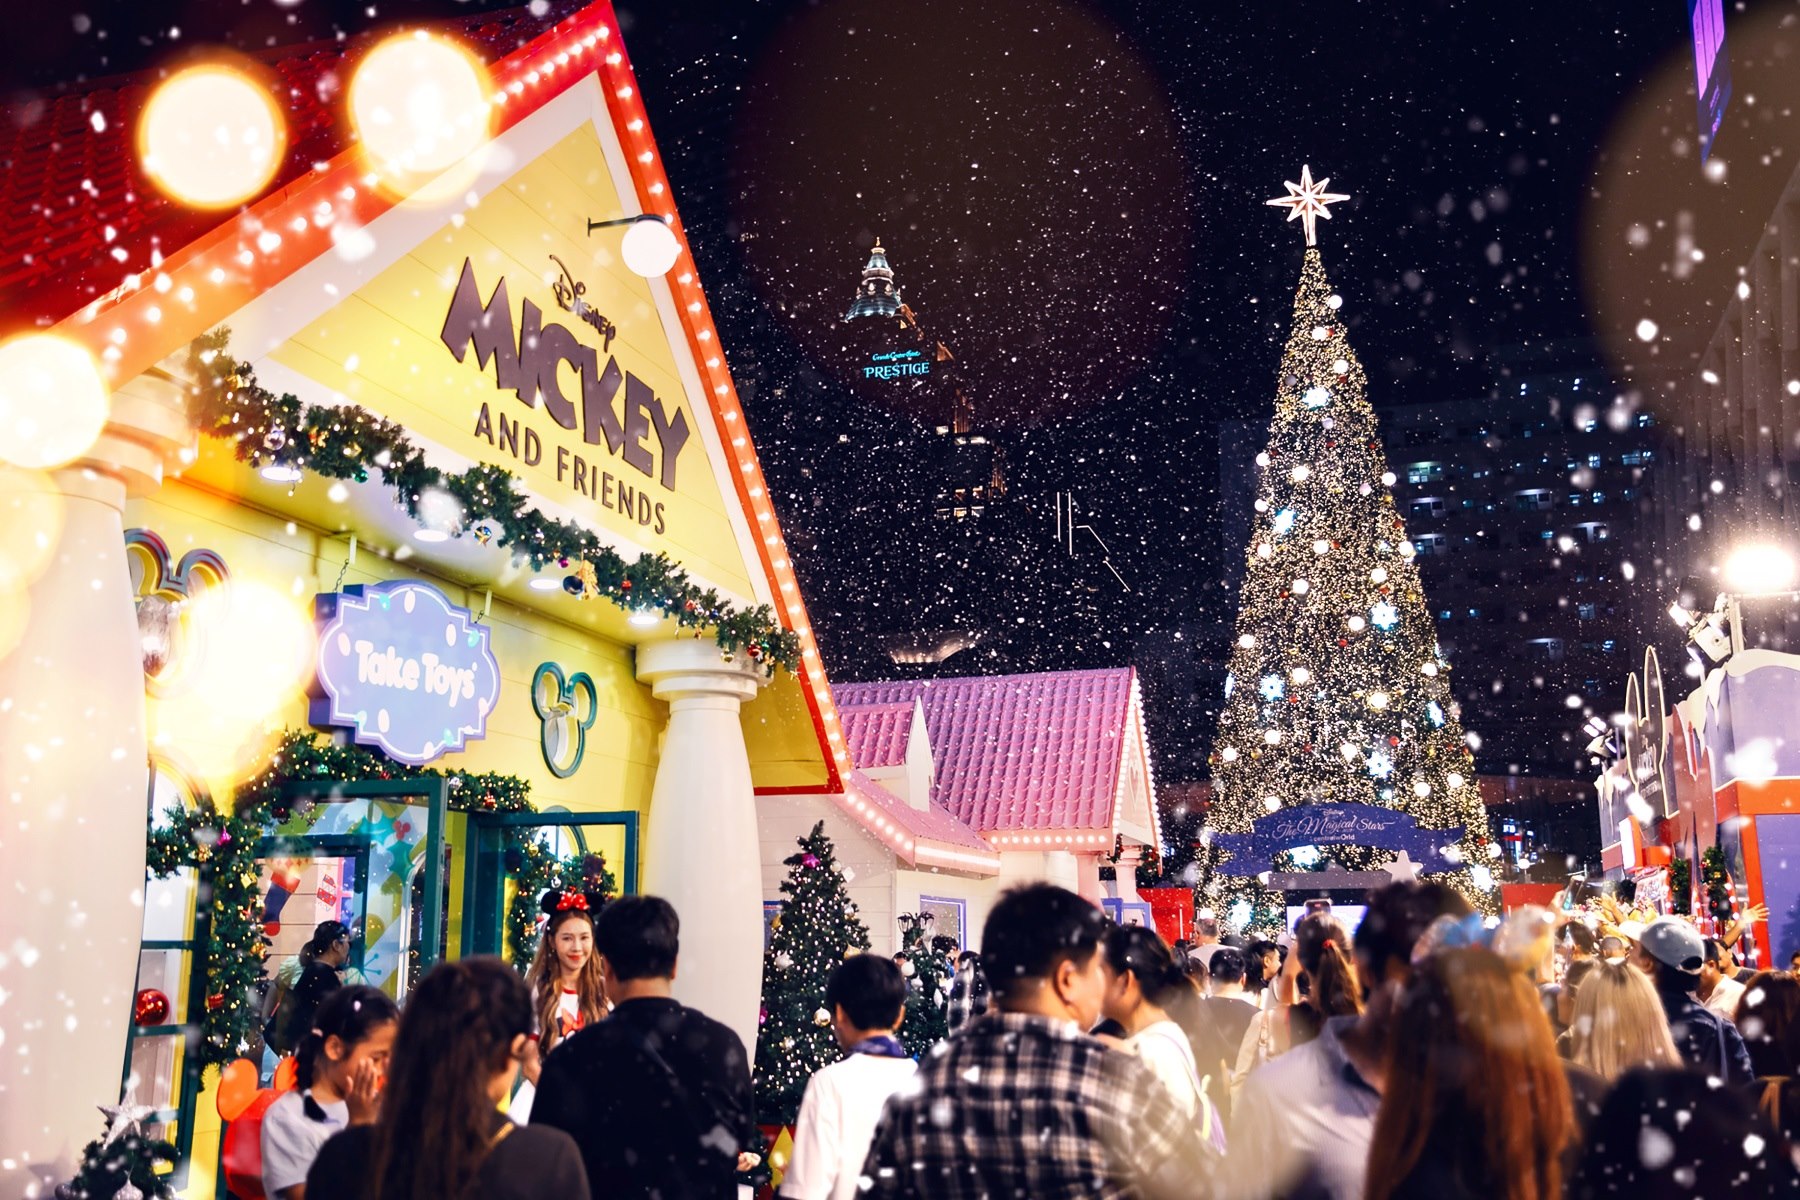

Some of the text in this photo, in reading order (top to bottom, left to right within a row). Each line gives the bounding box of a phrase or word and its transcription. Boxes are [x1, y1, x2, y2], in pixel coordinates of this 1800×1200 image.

[549, 254, 616, 353] Disney
[440, 256, 690, 491] MICKEY
[864, 362, 930, 379] PRESTIGE
[475, 402, 665, 535] AND FRIENDS
[355, 640, 420, 691] Take
[1297, 816, 1358, 835] Magical
[1356, 818, 1395, 831] Stars
